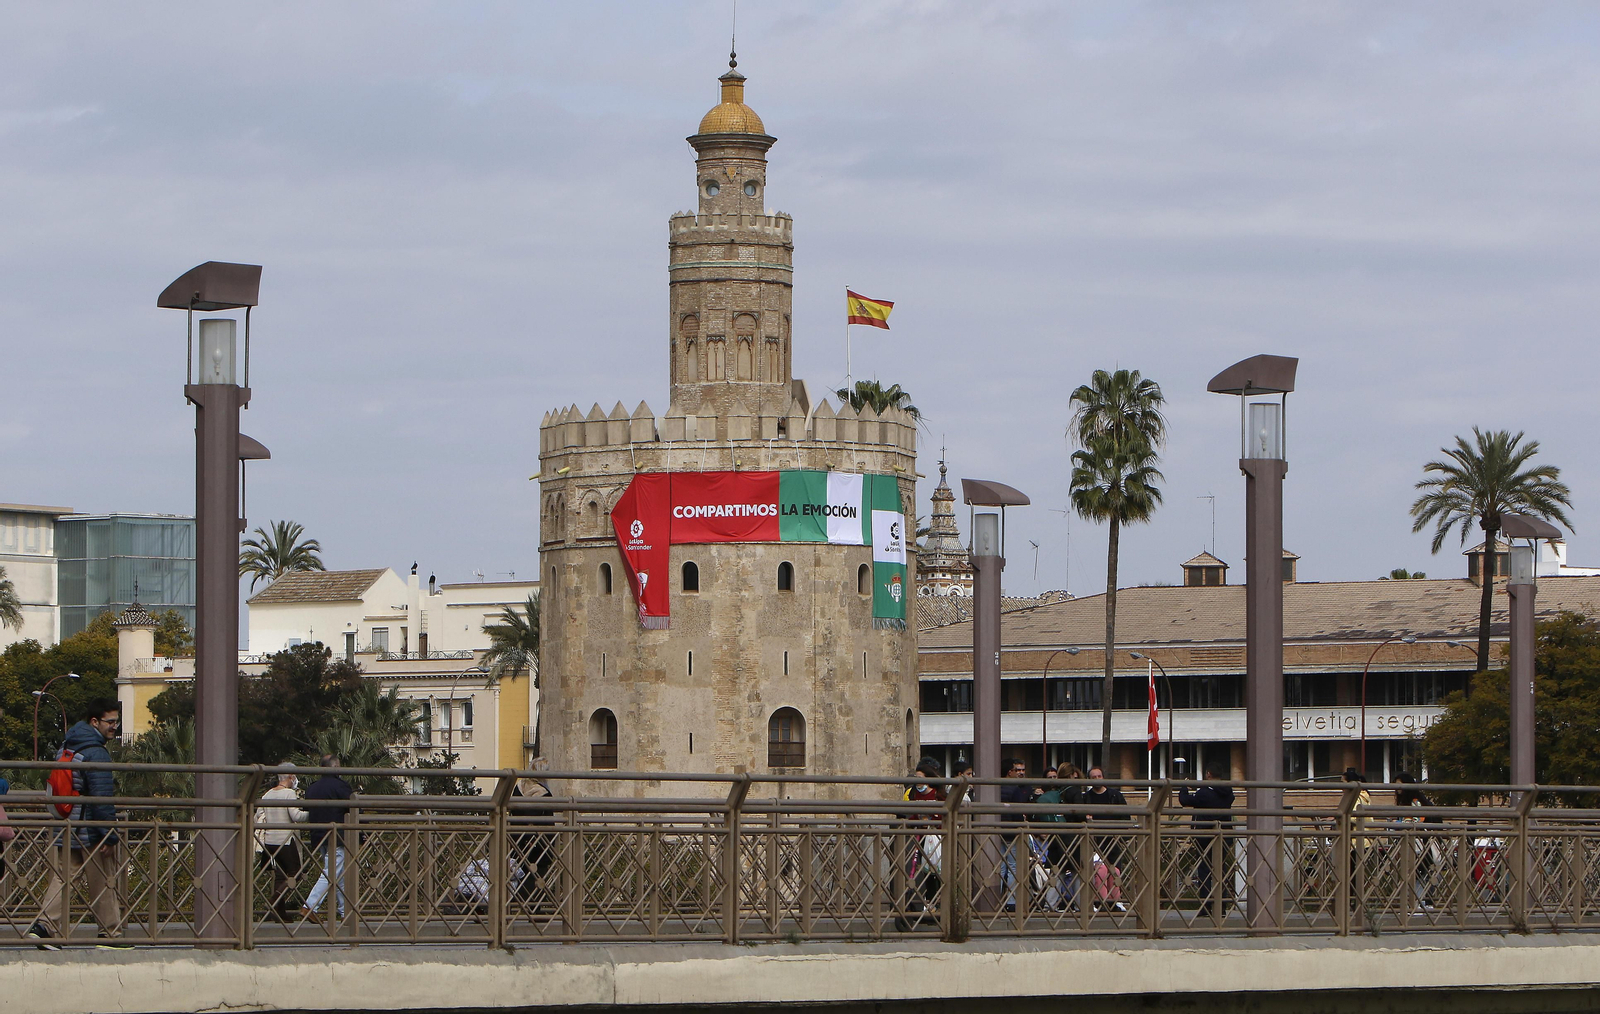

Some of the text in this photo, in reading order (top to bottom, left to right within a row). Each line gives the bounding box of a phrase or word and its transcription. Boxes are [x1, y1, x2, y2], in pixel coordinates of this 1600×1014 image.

[673, 502, 857, 519] COMPARTIMOS LA EMOCIÓN
[1282, 711, 1441, 734] elvetia segur
